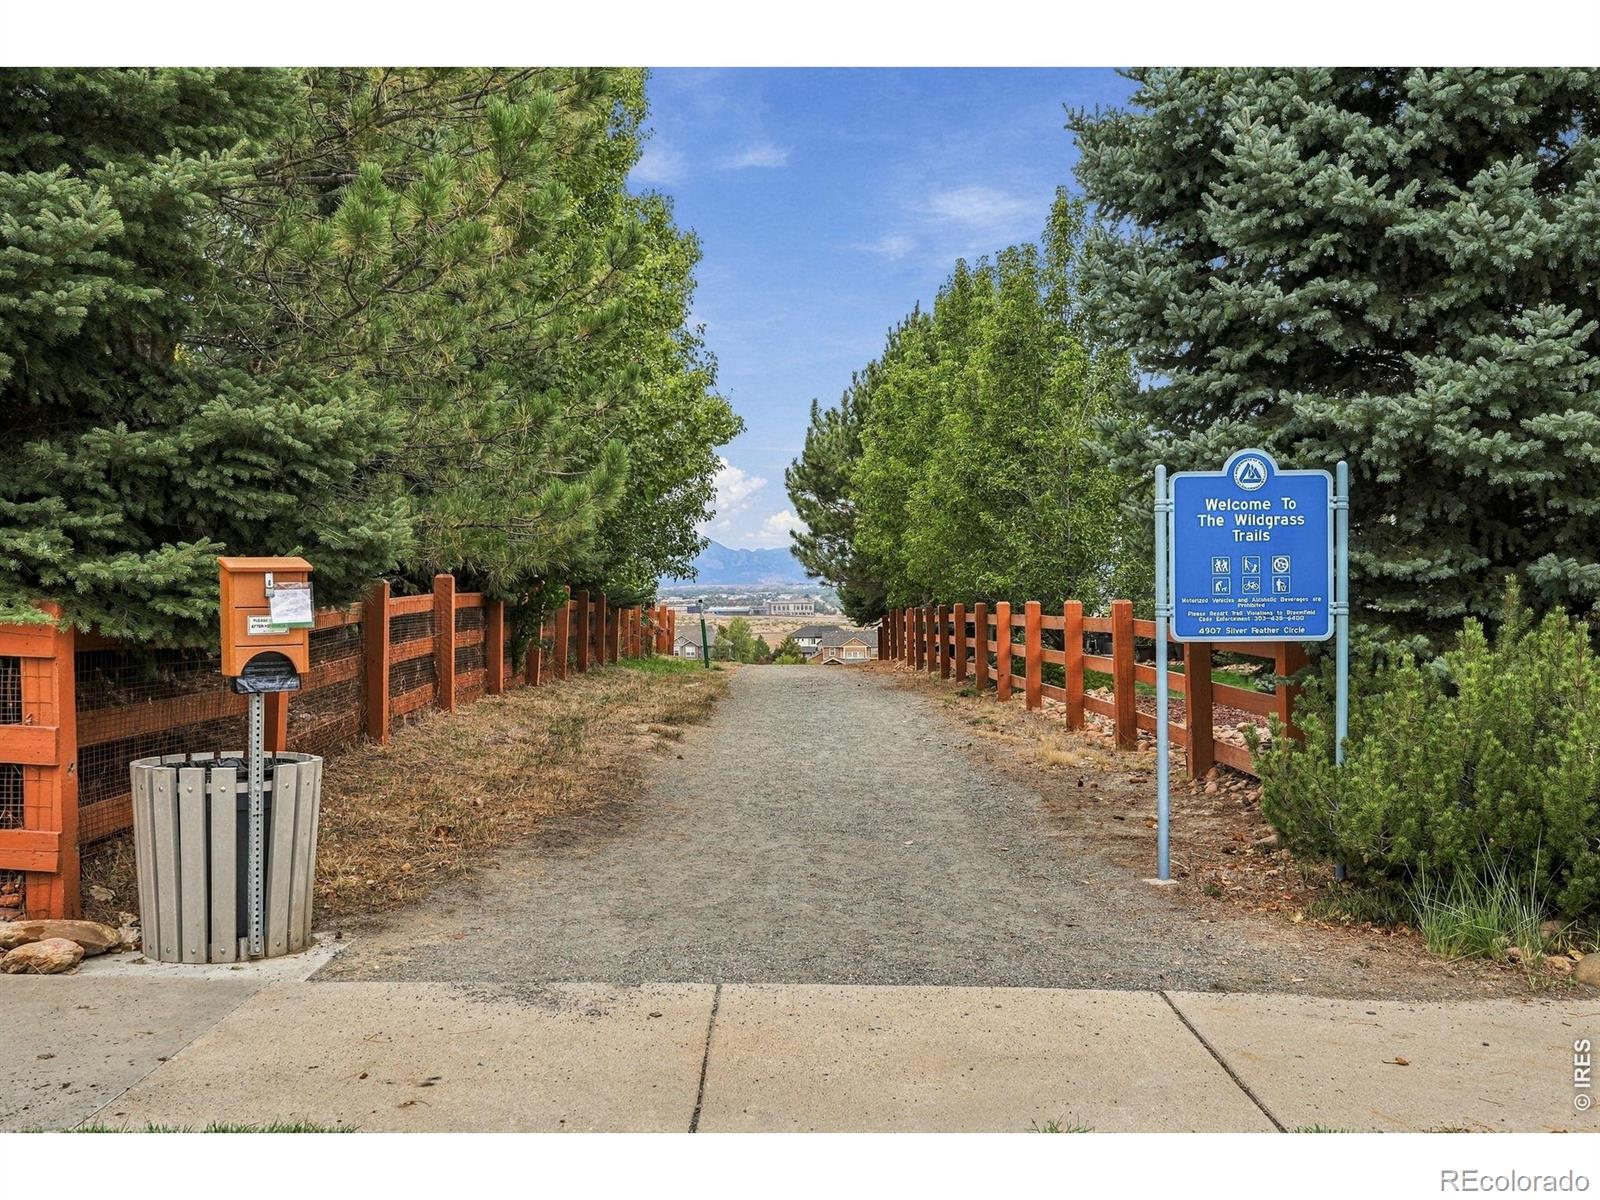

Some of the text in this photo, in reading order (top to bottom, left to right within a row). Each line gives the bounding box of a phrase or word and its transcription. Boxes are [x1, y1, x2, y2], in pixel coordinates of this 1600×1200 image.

[1205, 497, 1297, 511] Welcome To
[1197, 513, 1305, 530] The Wildgrass
[1232, 529, 1271, 542] Trails
[1251, 626, 1280, 634] Feather
[1283, 626, 1306, 634] Circle
